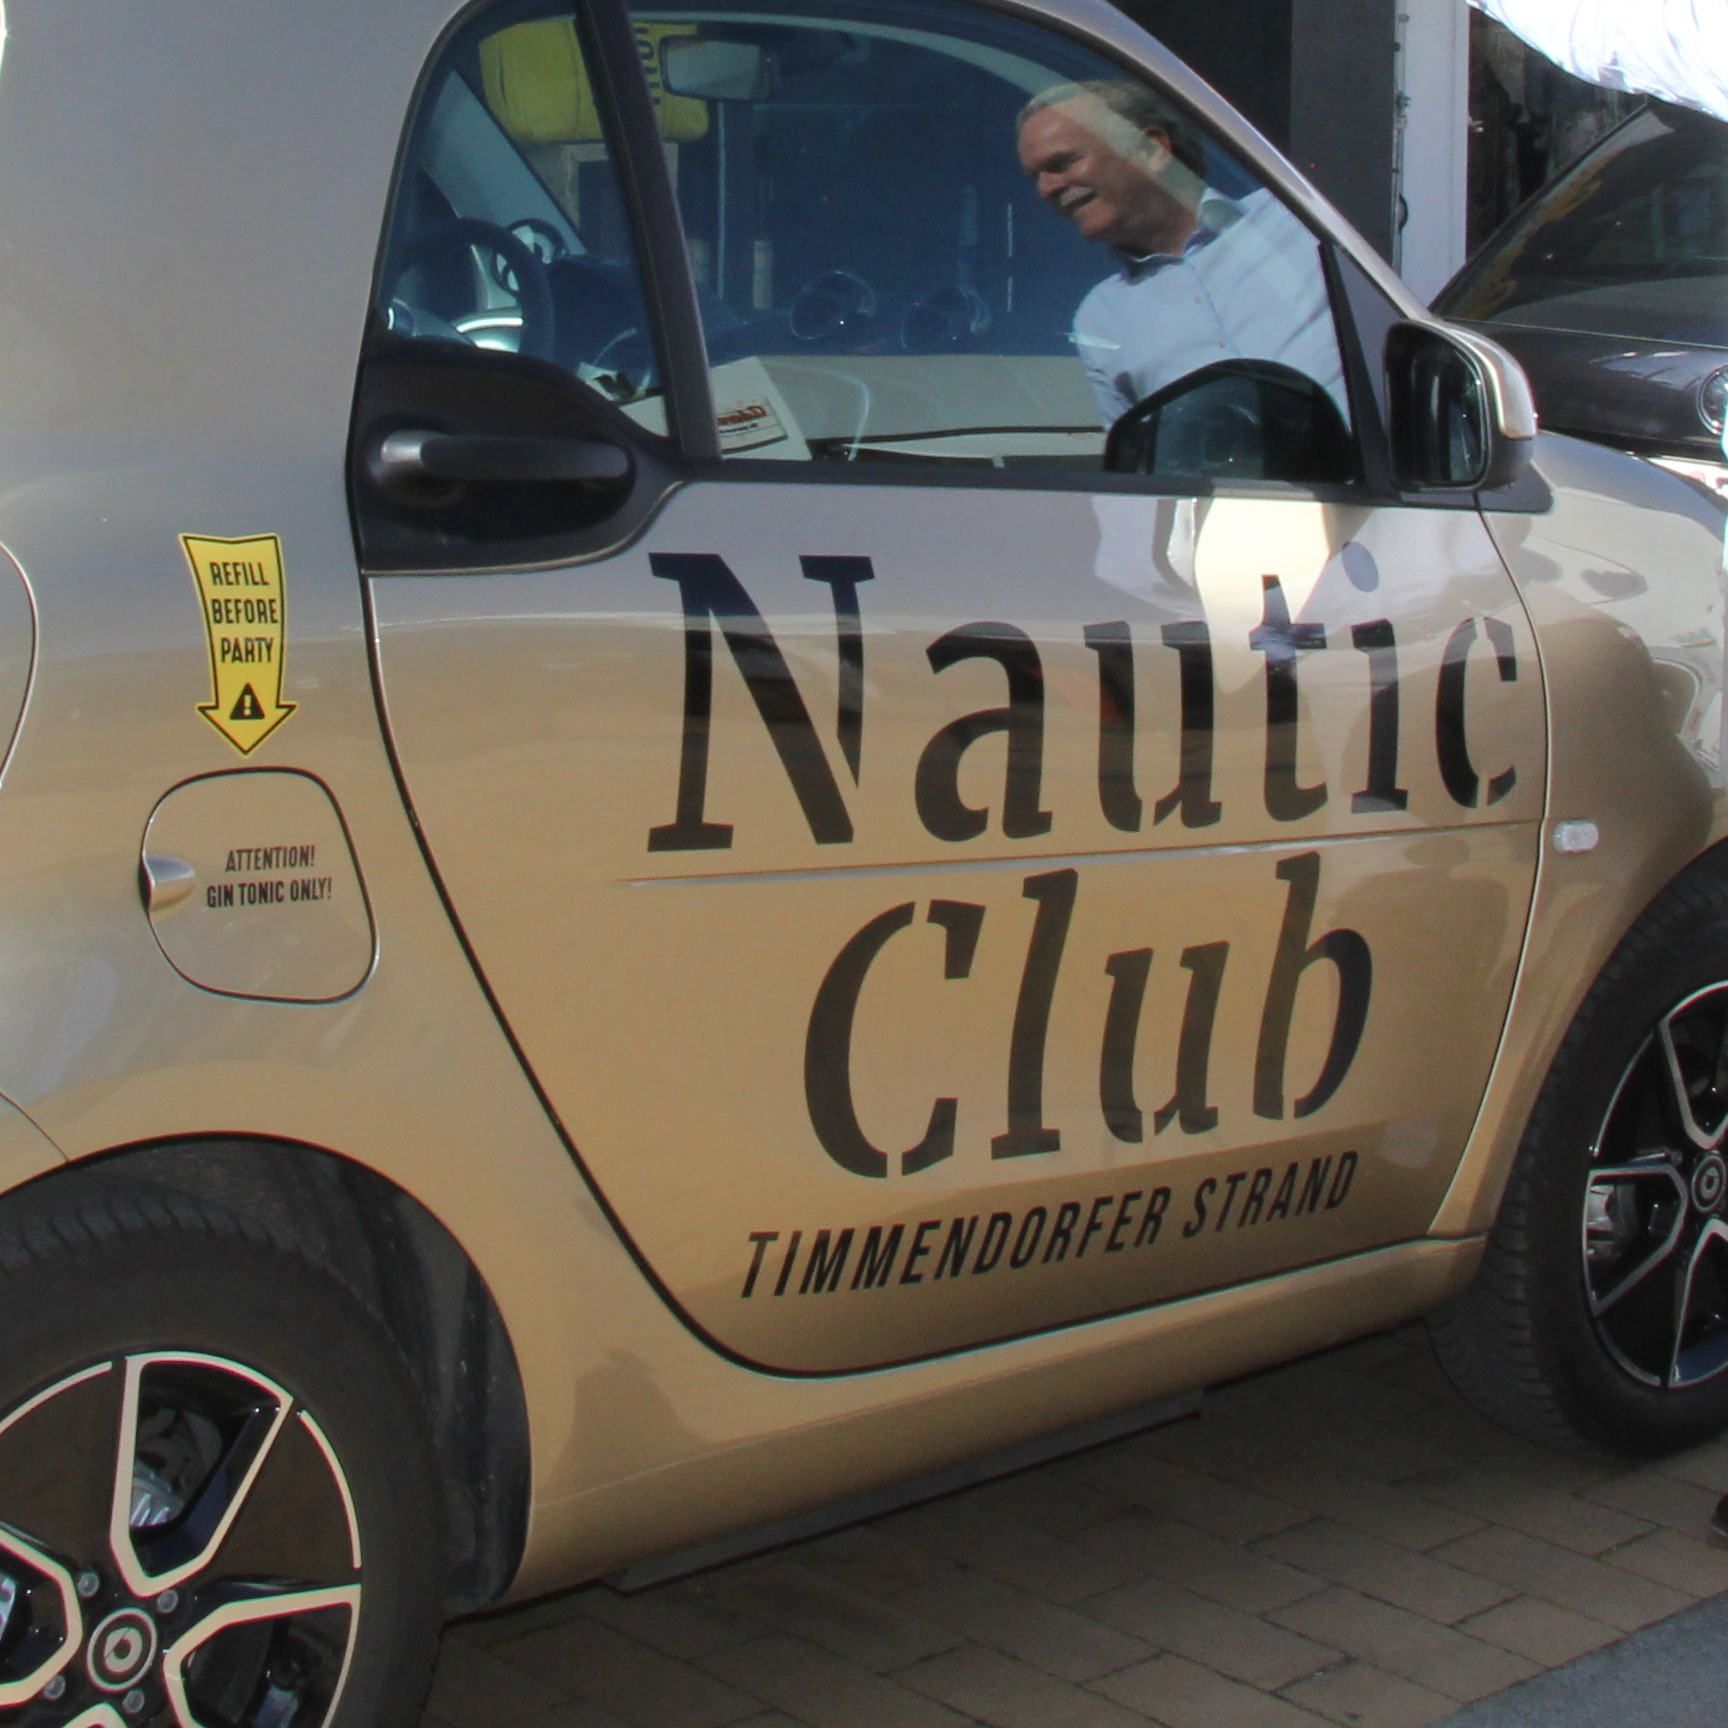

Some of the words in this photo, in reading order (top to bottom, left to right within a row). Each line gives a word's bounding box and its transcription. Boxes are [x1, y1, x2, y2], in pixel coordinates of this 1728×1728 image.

[209, 561, 270, 587] REFILL
[211, 598, 279, 624] BEFORE
[220, 636, 275, 664] PARTY
[647, 540, 1519, 853] Nautic
[224, 844, 316, 874] ATTENTION!
[206, 883, 235, 909] GIN
[238, 880, 285, 905] TONIC
[289, 876, 333, 902] ONLY!
[803, 850, 1374, 1179] Club
[740, 1186, 1172, 1299] TIMMENDORFER
[1181, 1150, 1360, 1239] STRAND
